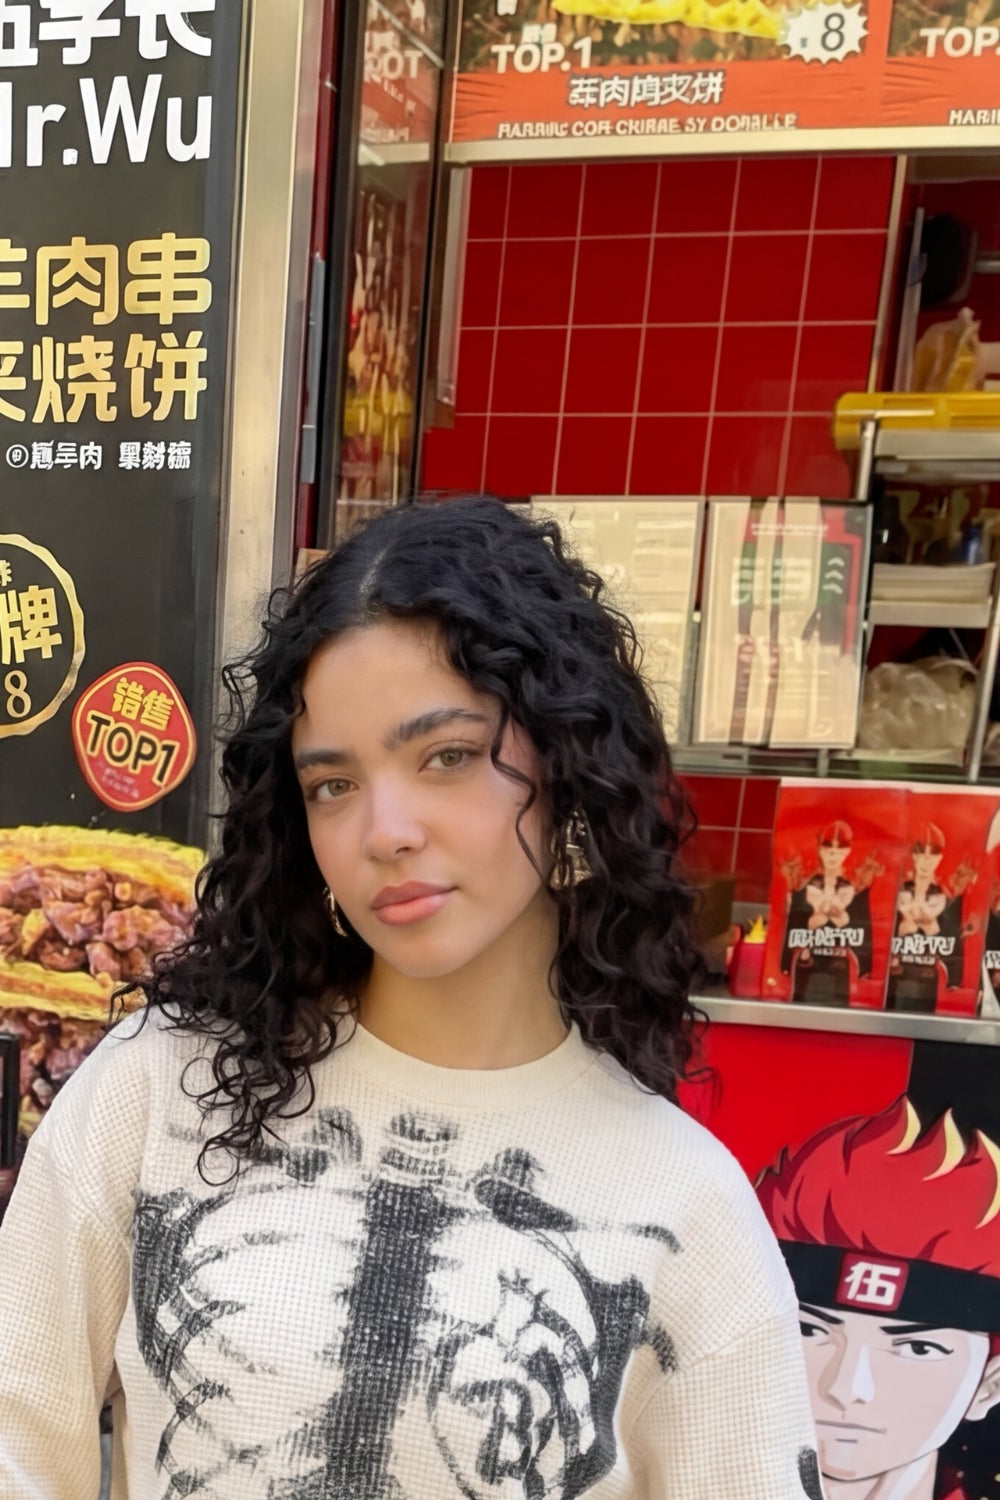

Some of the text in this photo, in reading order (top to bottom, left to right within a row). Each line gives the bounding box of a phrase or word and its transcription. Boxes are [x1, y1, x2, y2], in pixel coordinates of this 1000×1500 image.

[491, 37, 592, 73] TOP.1
[88, 711, 179, 786] TOP1
[844, 1261, 901, 1306] 伍
